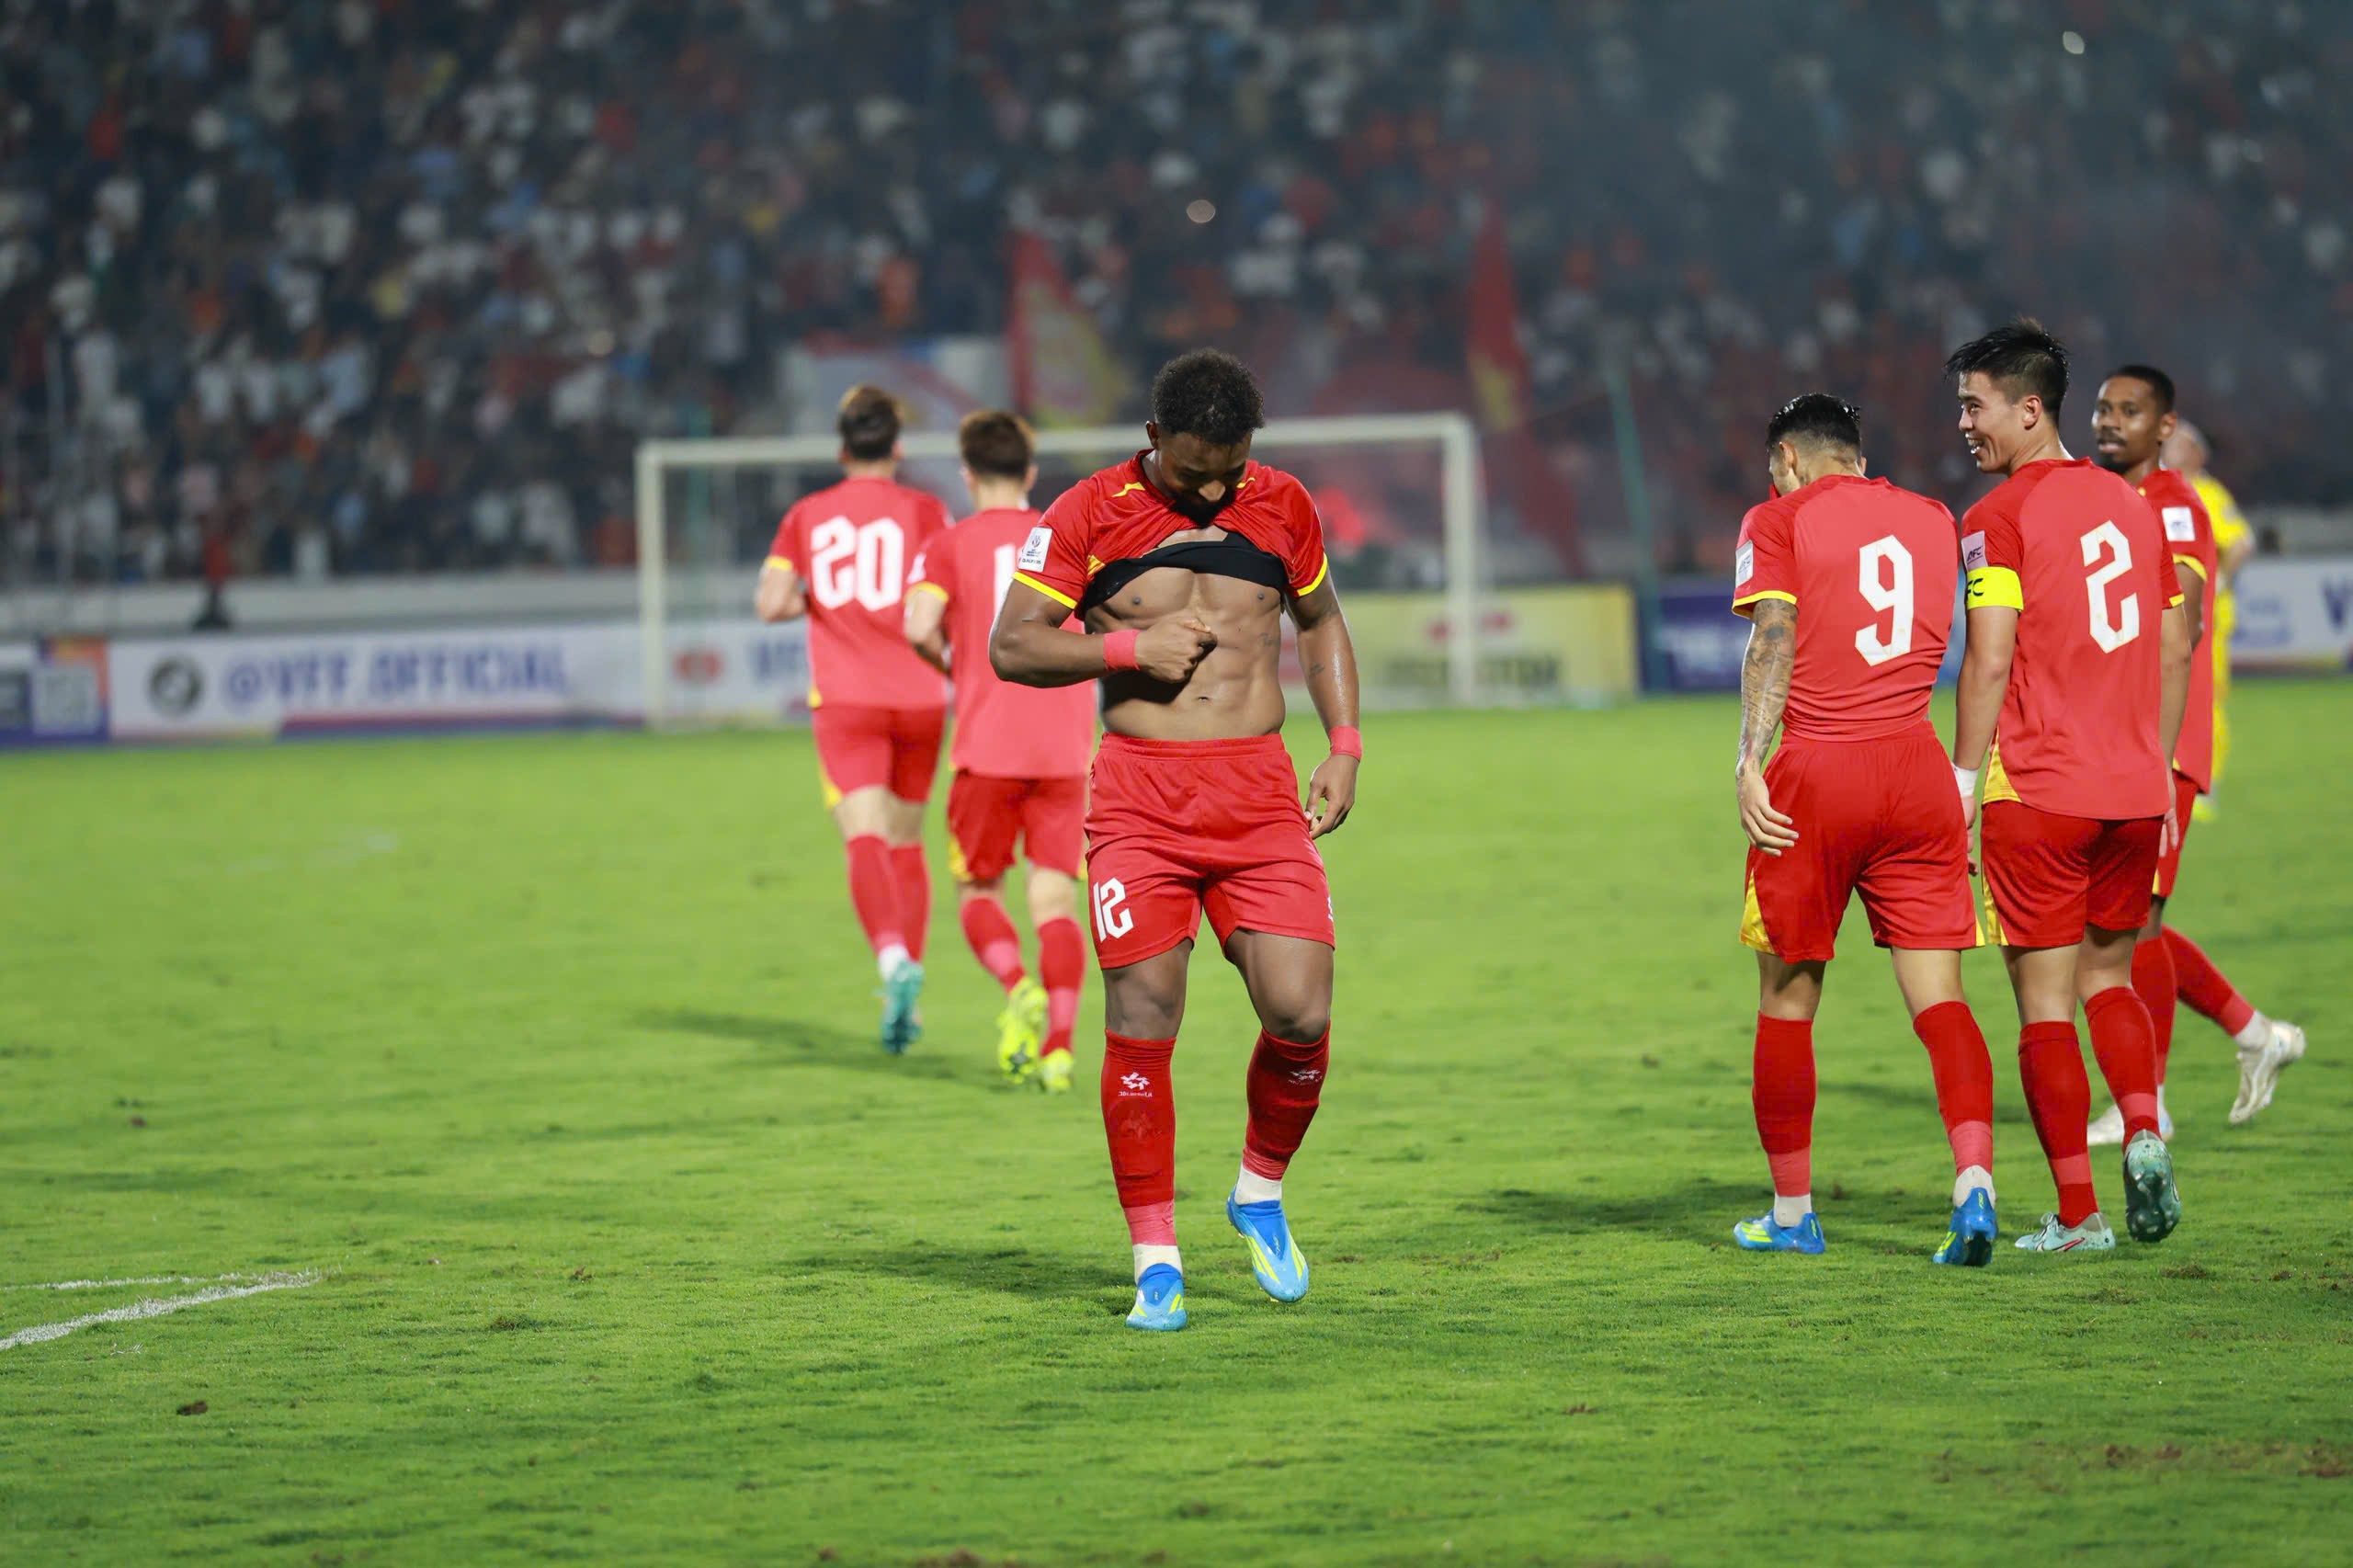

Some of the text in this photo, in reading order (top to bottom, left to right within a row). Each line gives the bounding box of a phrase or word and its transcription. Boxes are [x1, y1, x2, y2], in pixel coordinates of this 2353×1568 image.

[810, 516, 904, 611] 20
[1855, 534, 1915, 666] 9
[1966, 577, 1984, 597] FC
[2080, 520, 2140, 653] 2
[1093, 877, 1134, 943] 12
